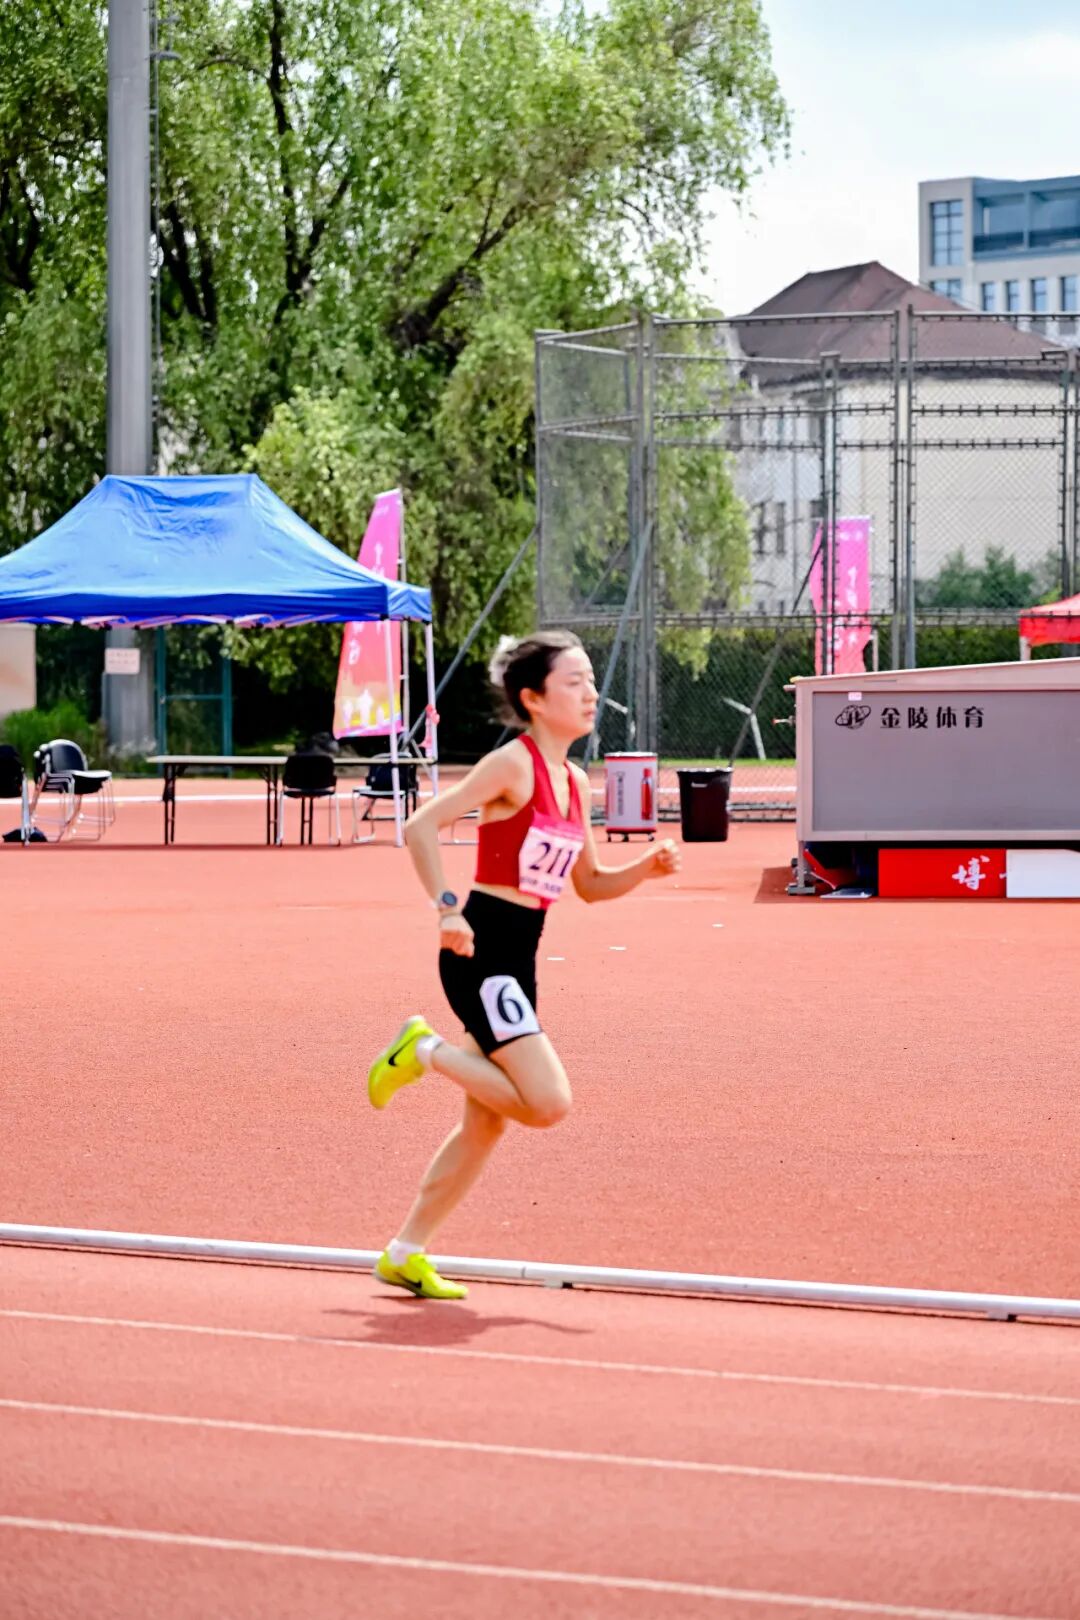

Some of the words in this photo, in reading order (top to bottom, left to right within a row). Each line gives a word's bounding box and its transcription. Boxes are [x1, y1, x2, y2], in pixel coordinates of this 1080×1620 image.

[880, 706, 984, 729] 金陵体育
[529, 842, 573, 877] 211
[497, 982, 523, 1024] 6
